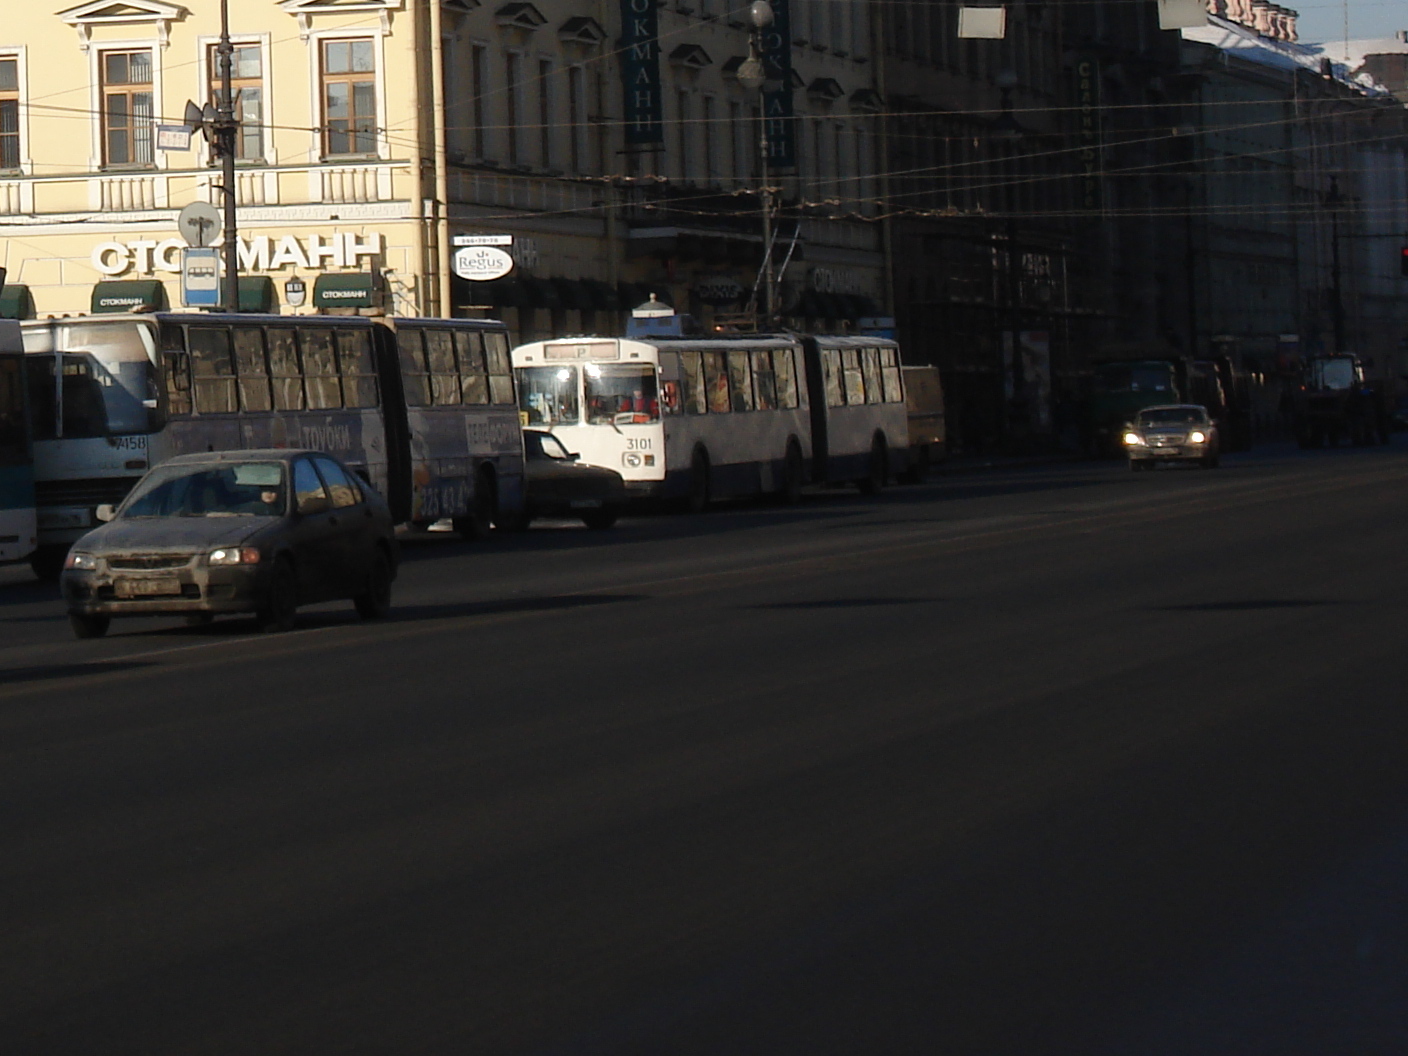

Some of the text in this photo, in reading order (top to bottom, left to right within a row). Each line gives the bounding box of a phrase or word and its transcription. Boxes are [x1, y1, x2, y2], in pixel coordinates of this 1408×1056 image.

[91, 232, 381, 275] СТОМАНН
[459, 256, 504, 270] Regus
[100, 297, 144, 306] СТОКМАНН
[626, 438, 652, 450] 3101
